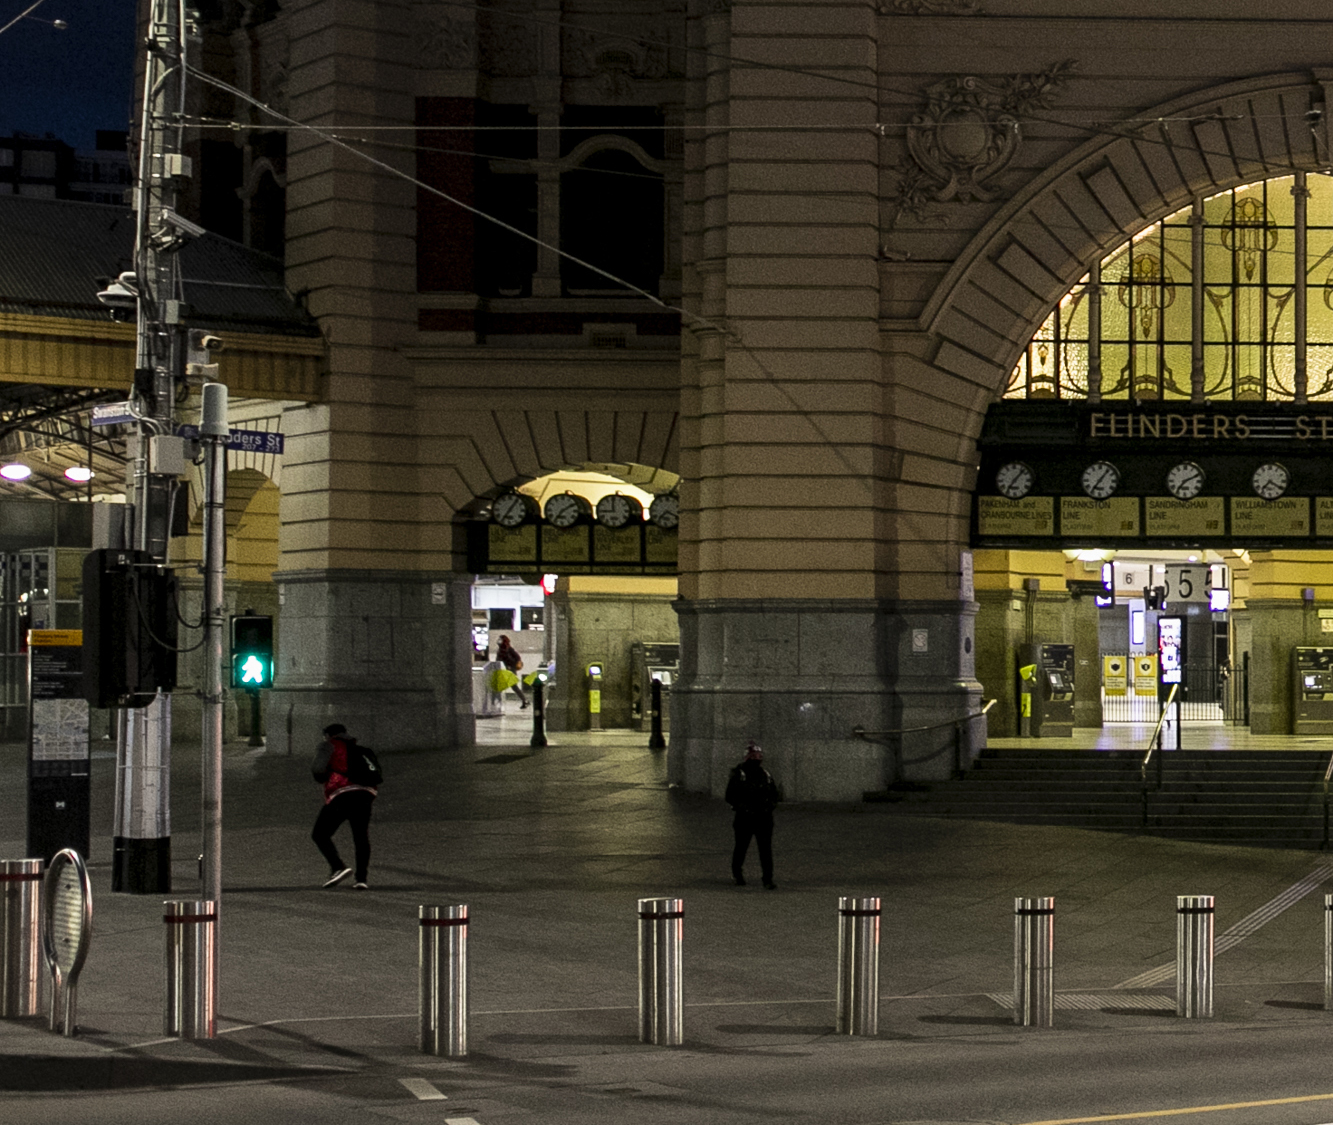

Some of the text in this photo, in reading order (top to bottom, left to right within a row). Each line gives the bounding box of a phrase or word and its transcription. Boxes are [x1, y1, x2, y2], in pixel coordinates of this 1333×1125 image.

[1090, 412, 1251, 439] FLINDERS
[267, 433, 280, 447] St
[980, 500, 1036, 509] PAKENHAM and
[1062, 500, 1111, 509] FRANKSTON
[1149, 500, 1208, 509] SANDRINGHAM
[1235, 500, 1297, 509] WILLIAMSTOWN
[980, 511, 1052, 520] CRANBOURNE LINES
[1062, 511, 1081, 520] LINE
[1149, 511, 1167, 520] LINE
[1235, 511, 1253, 520] LINE
[1125, 572, 1133, 585] 6
[1178, 569, 1193, 599] 5
